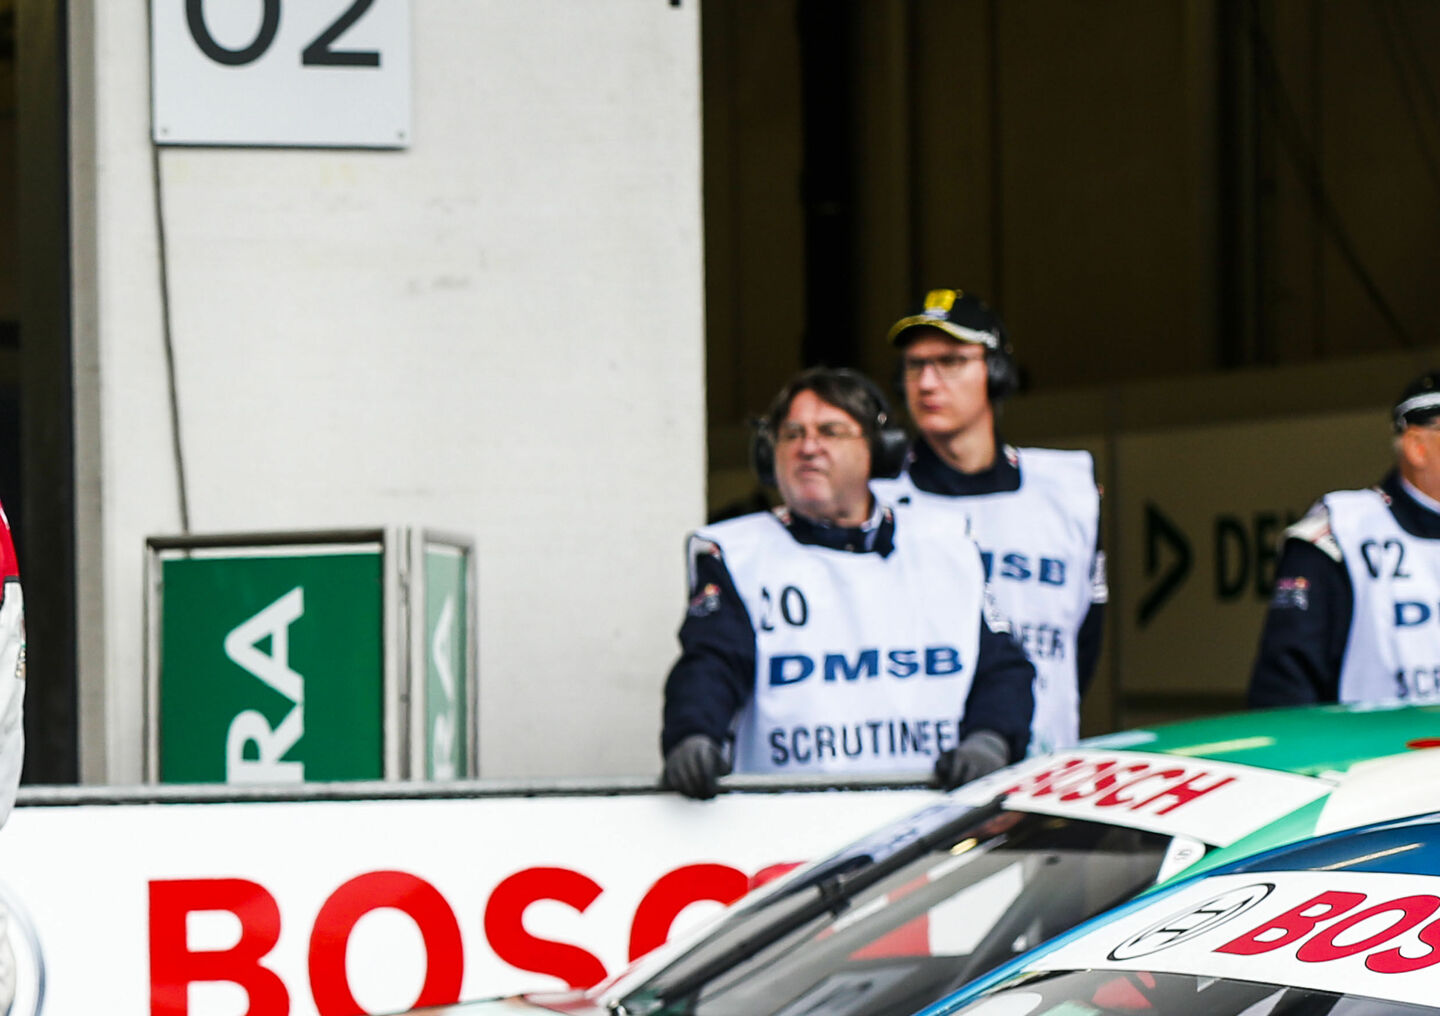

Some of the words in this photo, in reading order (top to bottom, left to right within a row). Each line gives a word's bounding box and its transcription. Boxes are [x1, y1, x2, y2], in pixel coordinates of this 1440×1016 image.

[1215, 512, 1284, 603] DE
[768, 645, 964, 688] DMSB
[769, 719, 954, 767] SCRUTINEE
